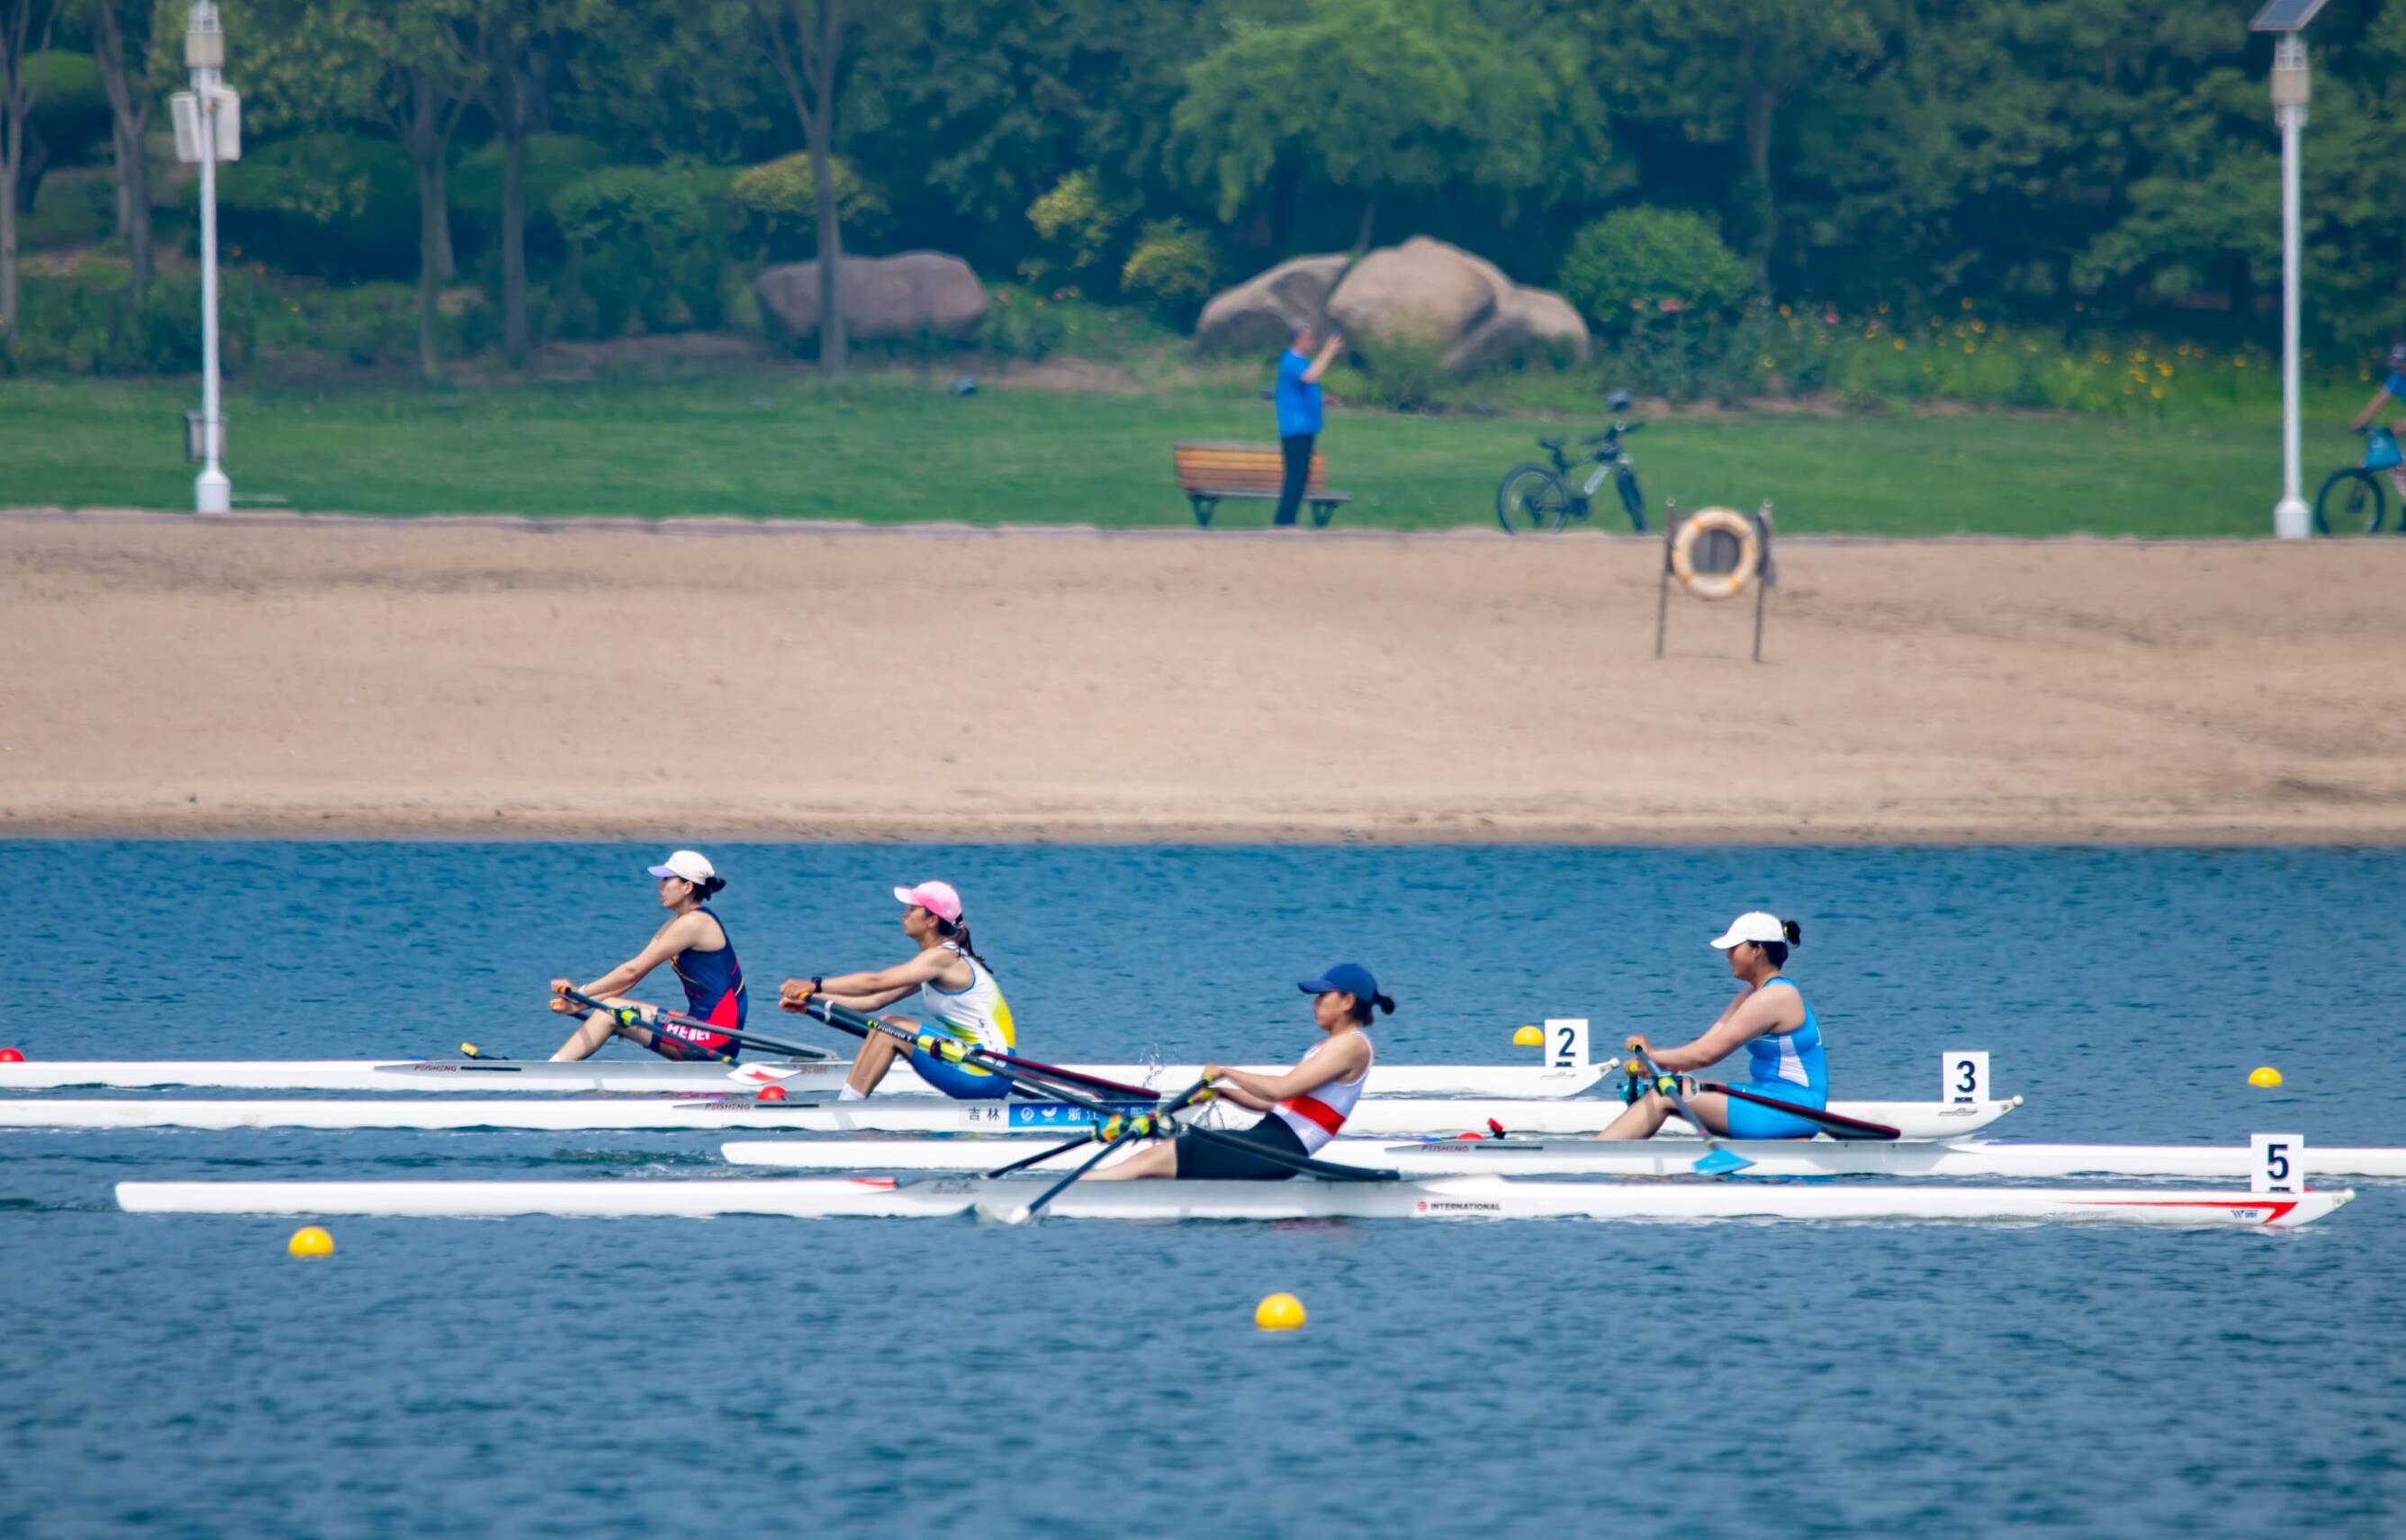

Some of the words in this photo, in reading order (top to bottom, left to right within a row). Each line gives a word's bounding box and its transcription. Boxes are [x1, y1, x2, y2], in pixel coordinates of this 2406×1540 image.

[1557, 1027, 1576, 1058] 2
[1956, 1060, 1976, 1093] 3
[968, 1107, 1000, 1121] 吉林
[2266, 1143, 2289, 1180] 5
[1429, 1202, 1501, 1211] INTERNATIONAL
